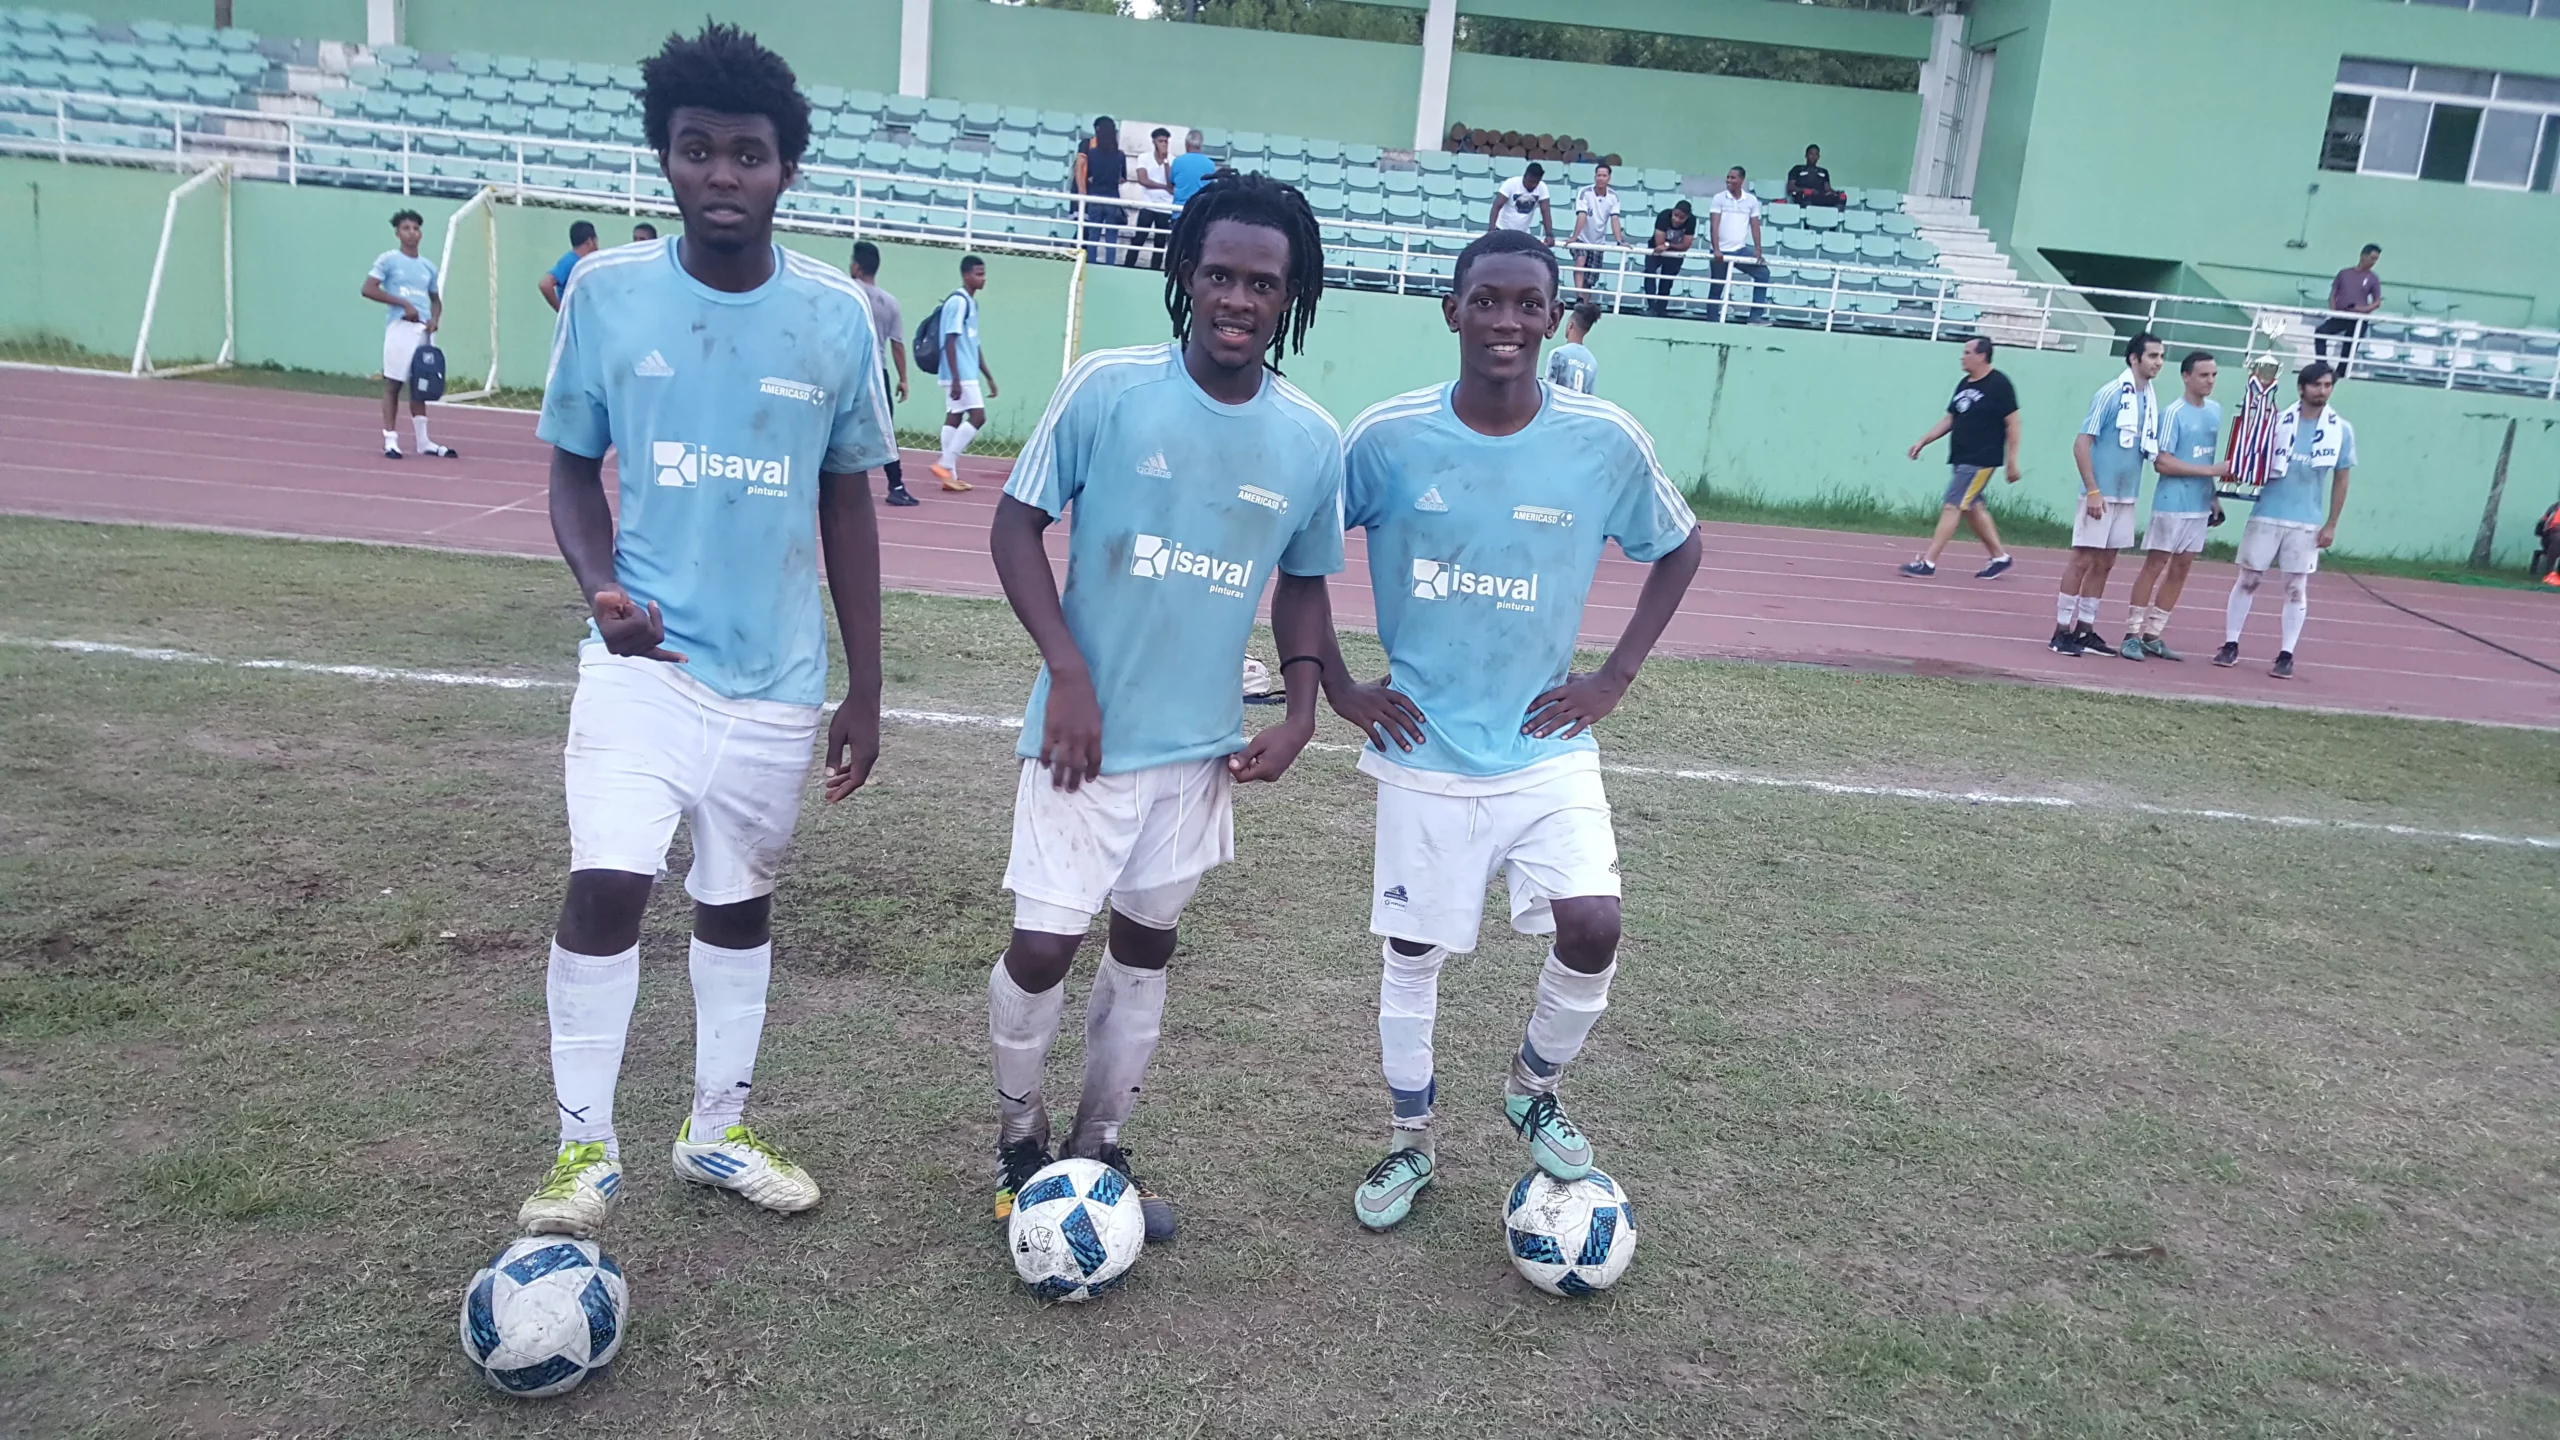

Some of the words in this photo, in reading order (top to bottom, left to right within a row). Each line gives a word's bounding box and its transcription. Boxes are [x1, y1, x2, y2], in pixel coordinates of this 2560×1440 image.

[700, 445, 790, 485] isaval
[747, 485, 788, 498] pinturas
[1171, 542, 1253, 587] isaval
[1209, 584, 1245, 599] pinturas
[1452, 564, 1538, 601] isaval
[1496, 600, 1535, 613] pinturas
